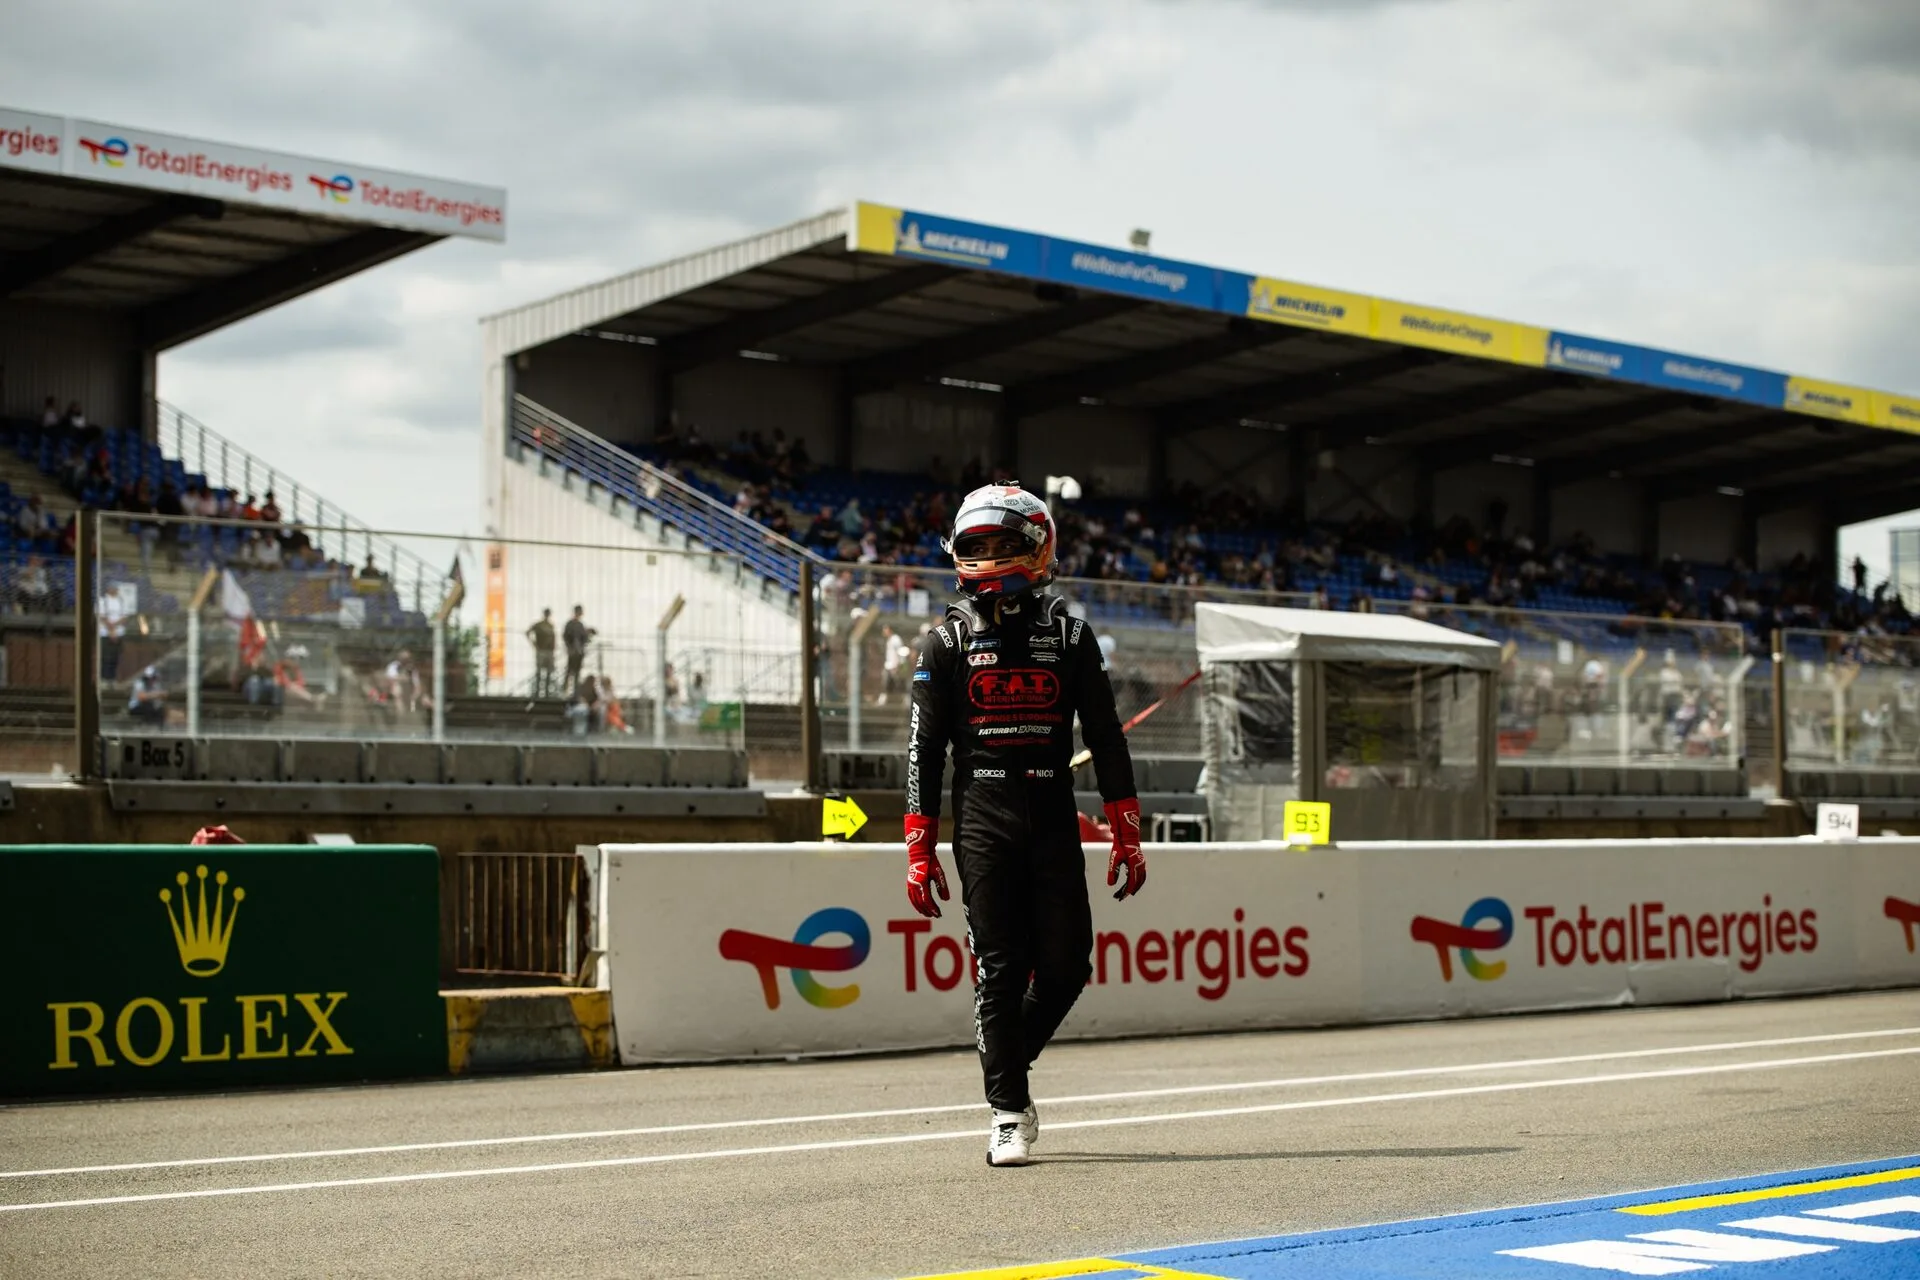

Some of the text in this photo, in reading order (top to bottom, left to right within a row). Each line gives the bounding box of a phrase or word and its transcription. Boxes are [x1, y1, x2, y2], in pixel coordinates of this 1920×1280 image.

[134, 144, 293, 193] TotalEnergies
[359, 179, 503, 226] TotalEnergies
[923, 231, 1009, 260] MICHELIN
[142, 740, 184, 768] Box 5
[973, 769, 1006, 778] sparco
[1036, 769, 1054, 778] NICO
[1294, 811, 1321, 834] 93
[1827, 810, 1853, 830] 94
[1524, 894, 1819, 972] TotalEnergies
[887, 907, 1310, 1001] Tonergies
[47, 991, 354, 1069] ROLEX
